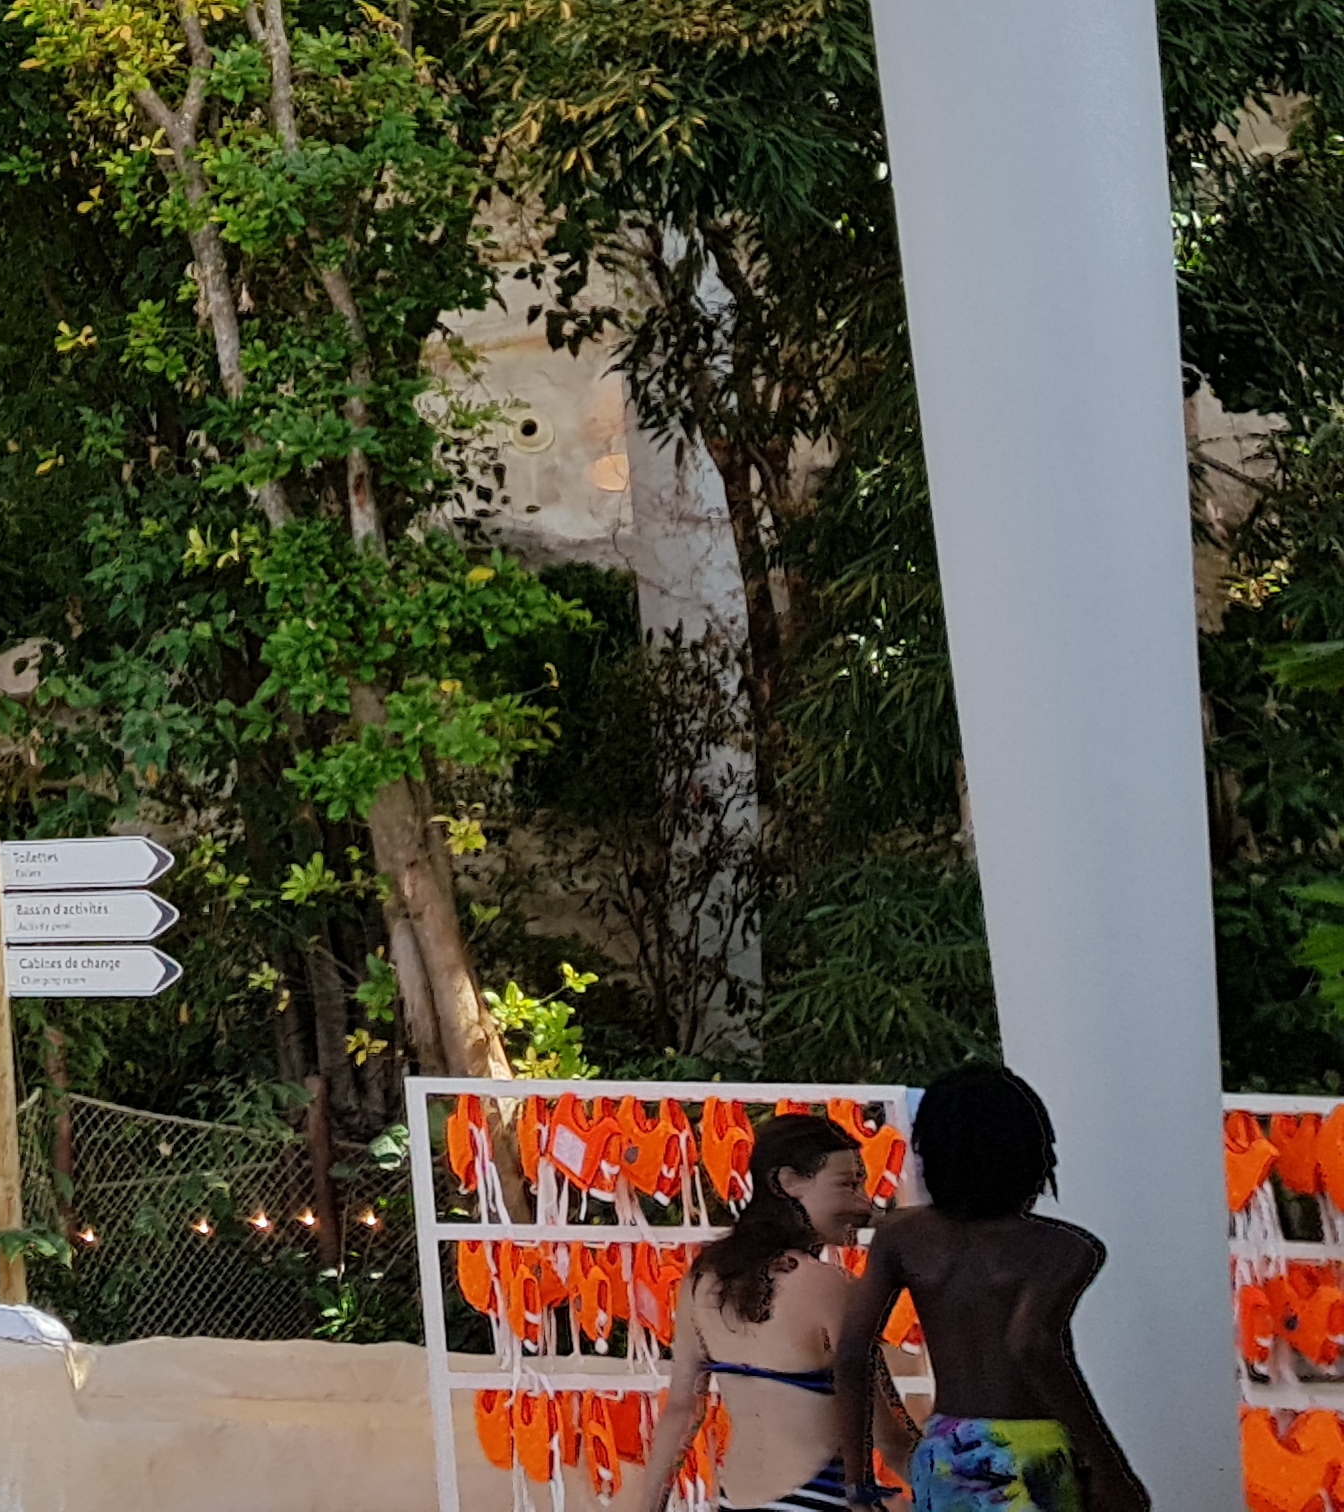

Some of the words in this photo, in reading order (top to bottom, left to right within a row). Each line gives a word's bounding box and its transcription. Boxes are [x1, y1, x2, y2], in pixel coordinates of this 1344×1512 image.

[16, 904, 50, 915] Bassin
[65, 956, 78, 969] de
[81, 956, 121, 971] change
